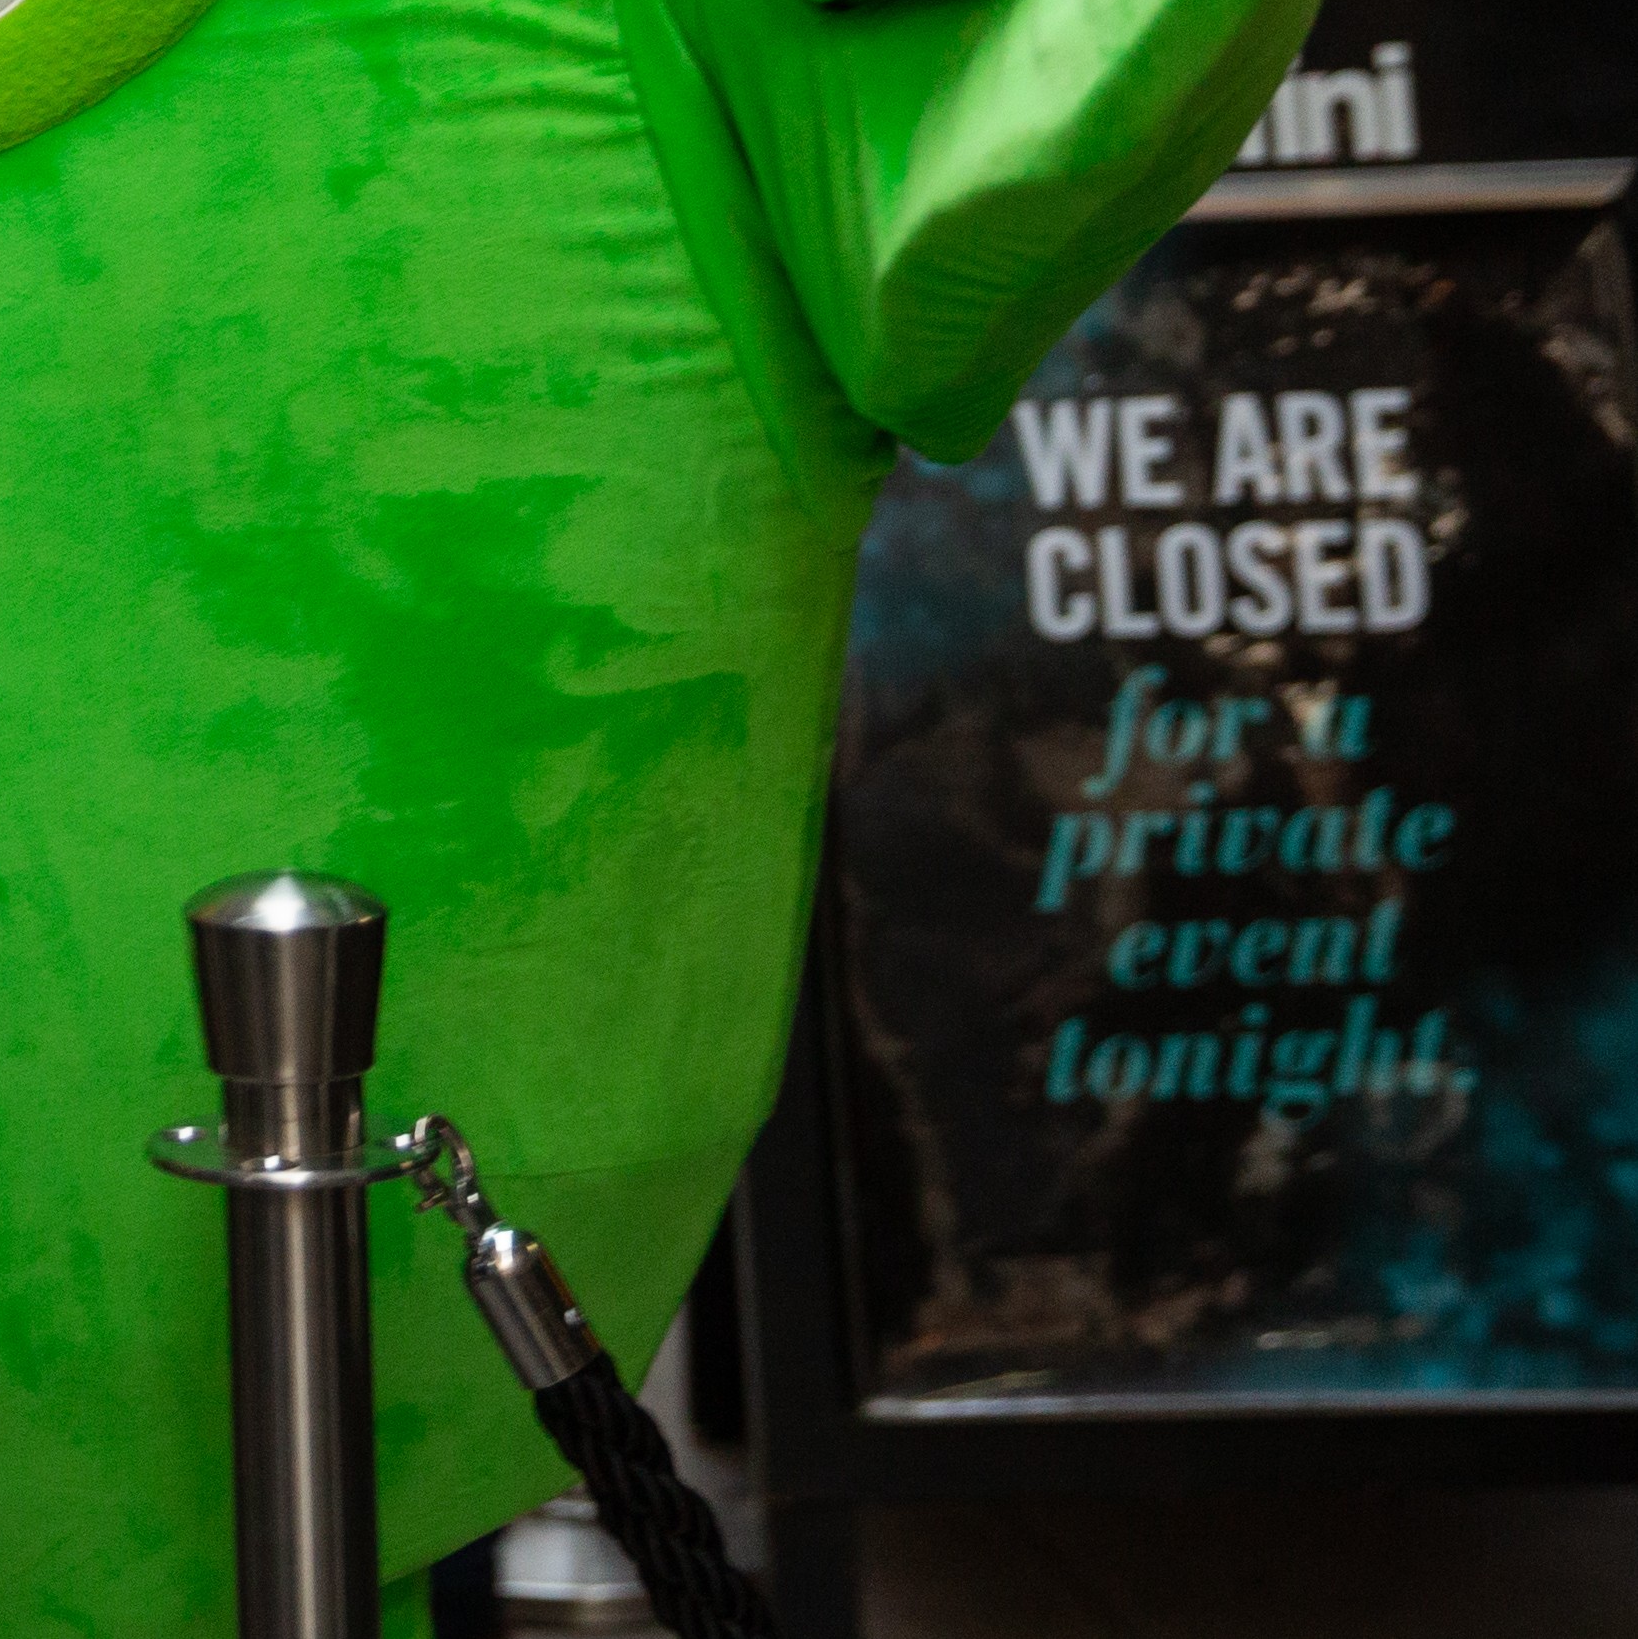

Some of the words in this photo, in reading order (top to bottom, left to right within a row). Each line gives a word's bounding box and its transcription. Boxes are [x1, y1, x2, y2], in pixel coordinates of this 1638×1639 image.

[1013, 393, 1184, 511] WE
[1213, 386, 1420, 503] ARE
[1026, 518, 1432, 641] CLOSED
[1083, 664, 1268, 799] for
[1035, 782, 1457, 912] private
[1107, 898, 1407, 990] event
